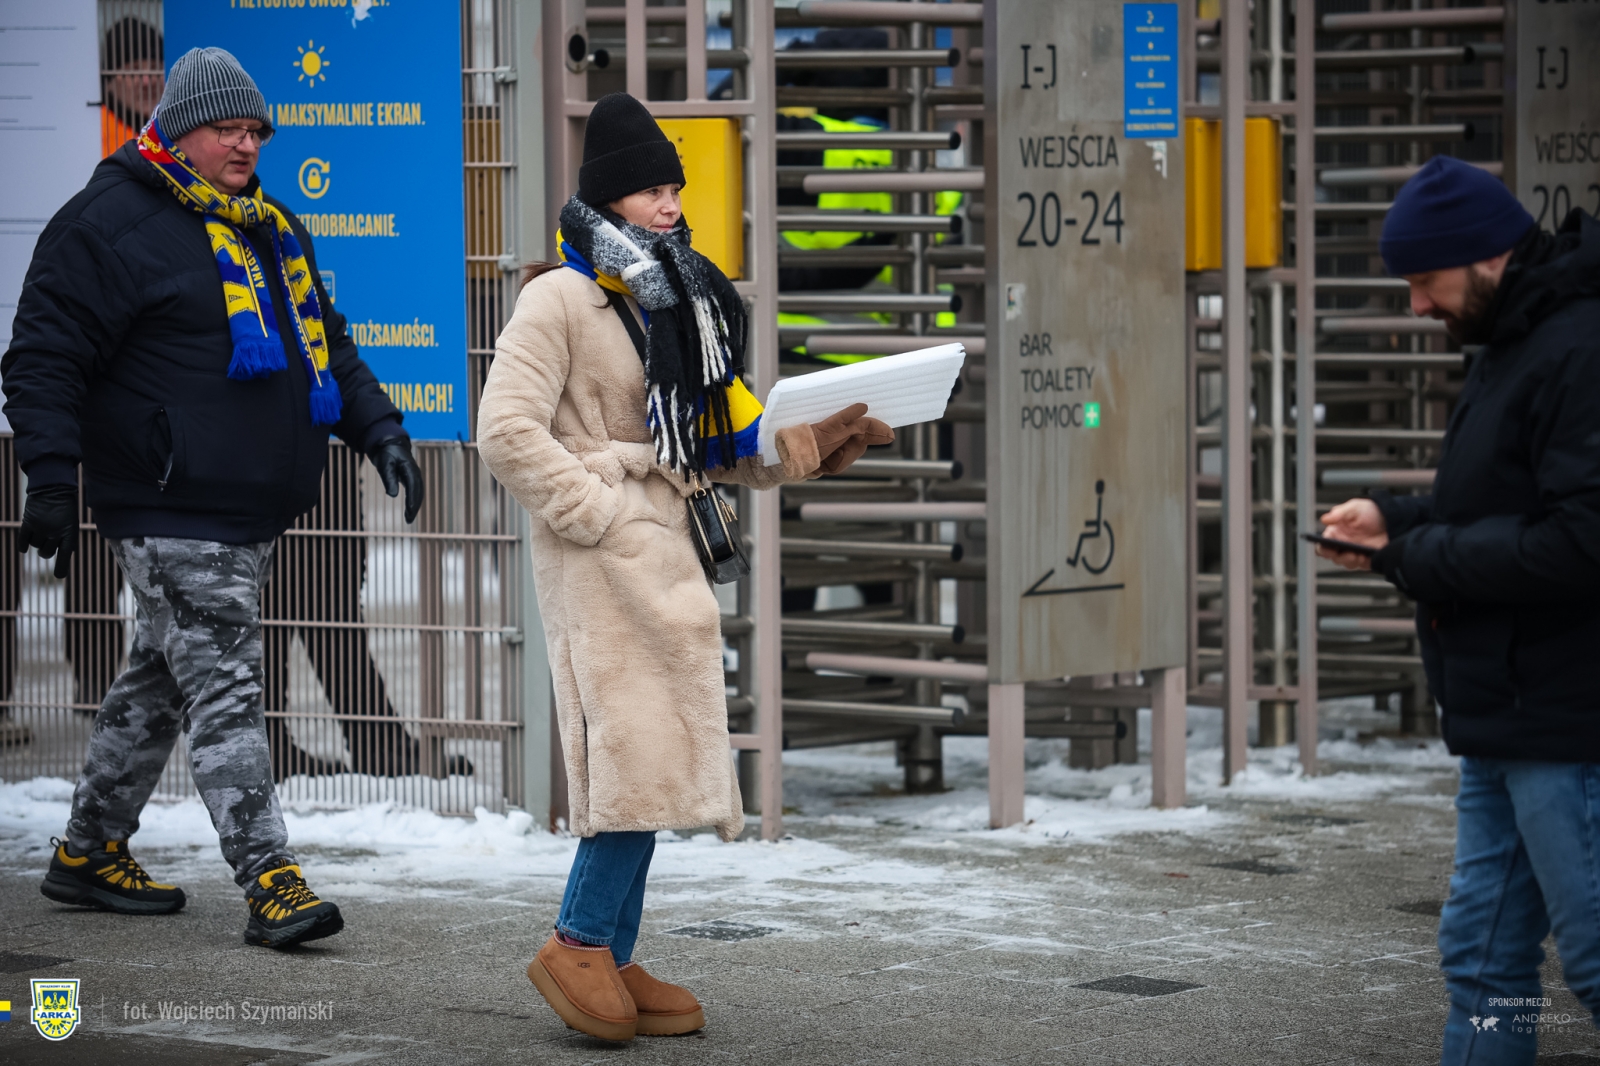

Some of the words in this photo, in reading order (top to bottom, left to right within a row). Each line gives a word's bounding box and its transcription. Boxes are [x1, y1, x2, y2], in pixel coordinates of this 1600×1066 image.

[1021, 44, 1057, 89] I-J
[1536, 46, 1569, 90] I-J
[277, 102, 374, 127] MAKSYMALNIE
[377, 102, 426, 126] EKRAN.
[1019, 125, 1119, 168] WEJŚCIA
[1017, 190, 1125, 247] 20-24
[351, 317, 439, 347] TOŻSAMOŚCI.
[1020, 332, 1053, 357] BAR
[1020, 366, 1095, 393] TOALETY
[1021, 403, 1083, 429] POMOC
